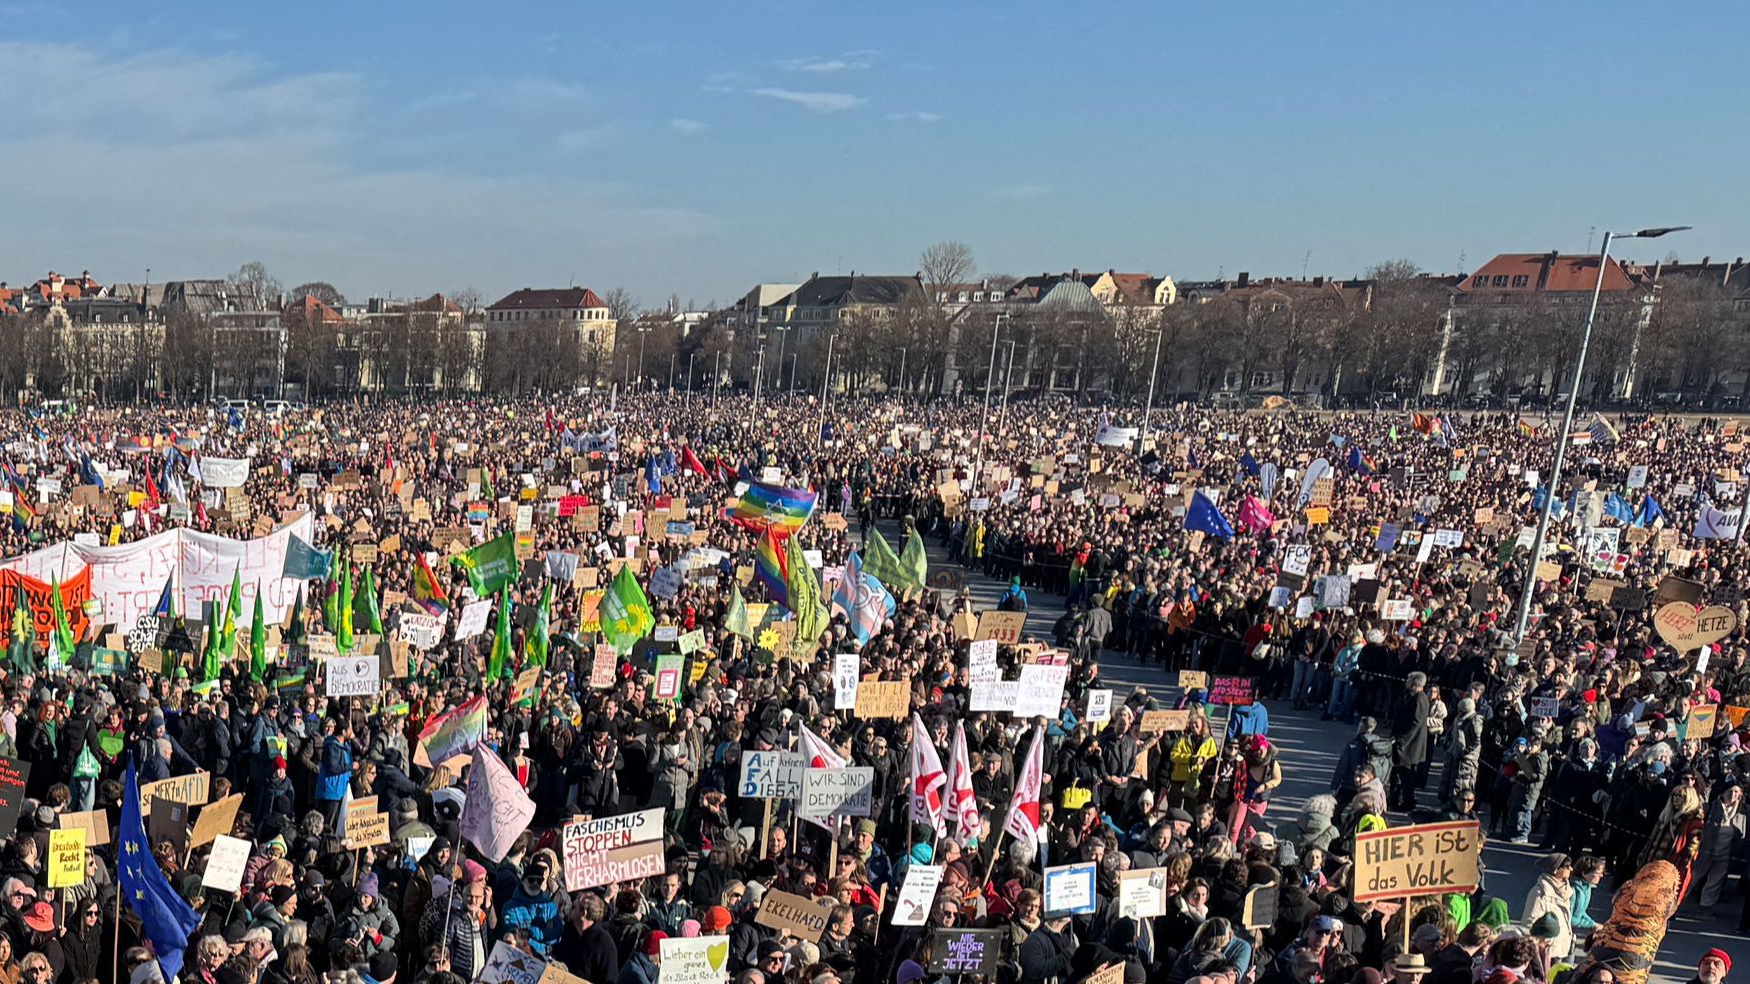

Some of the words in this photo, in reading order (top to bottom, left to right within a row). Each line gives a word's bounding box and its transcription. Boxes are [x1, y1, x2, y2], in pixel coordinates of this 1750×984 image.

[1287, 547, 1311, 558] FCK
[137, 616, 159, 629] CSU
[1697, 616, 1729, 633] HETZE
[809, 773, 836, 788] WIR
[839, 773, 866, 787] SIND
[808, 792, 868, 807] DEMOKRATIE
[565, 814, 646, 839] FASCHISMUS
[1366, 836, 1424, 865] HIER
[565, 850, 608, 868] NICHT
[566, 854, 664, 891] VERHARMLOSEN
[1367, 871, 1398, 891] das
[1407, 863, 1456, 889] Volk
[960, 934, 976, 943] NIE
[947, 941, 984, 952] WIEDER
[942, 960, 982, 970] JETZT
